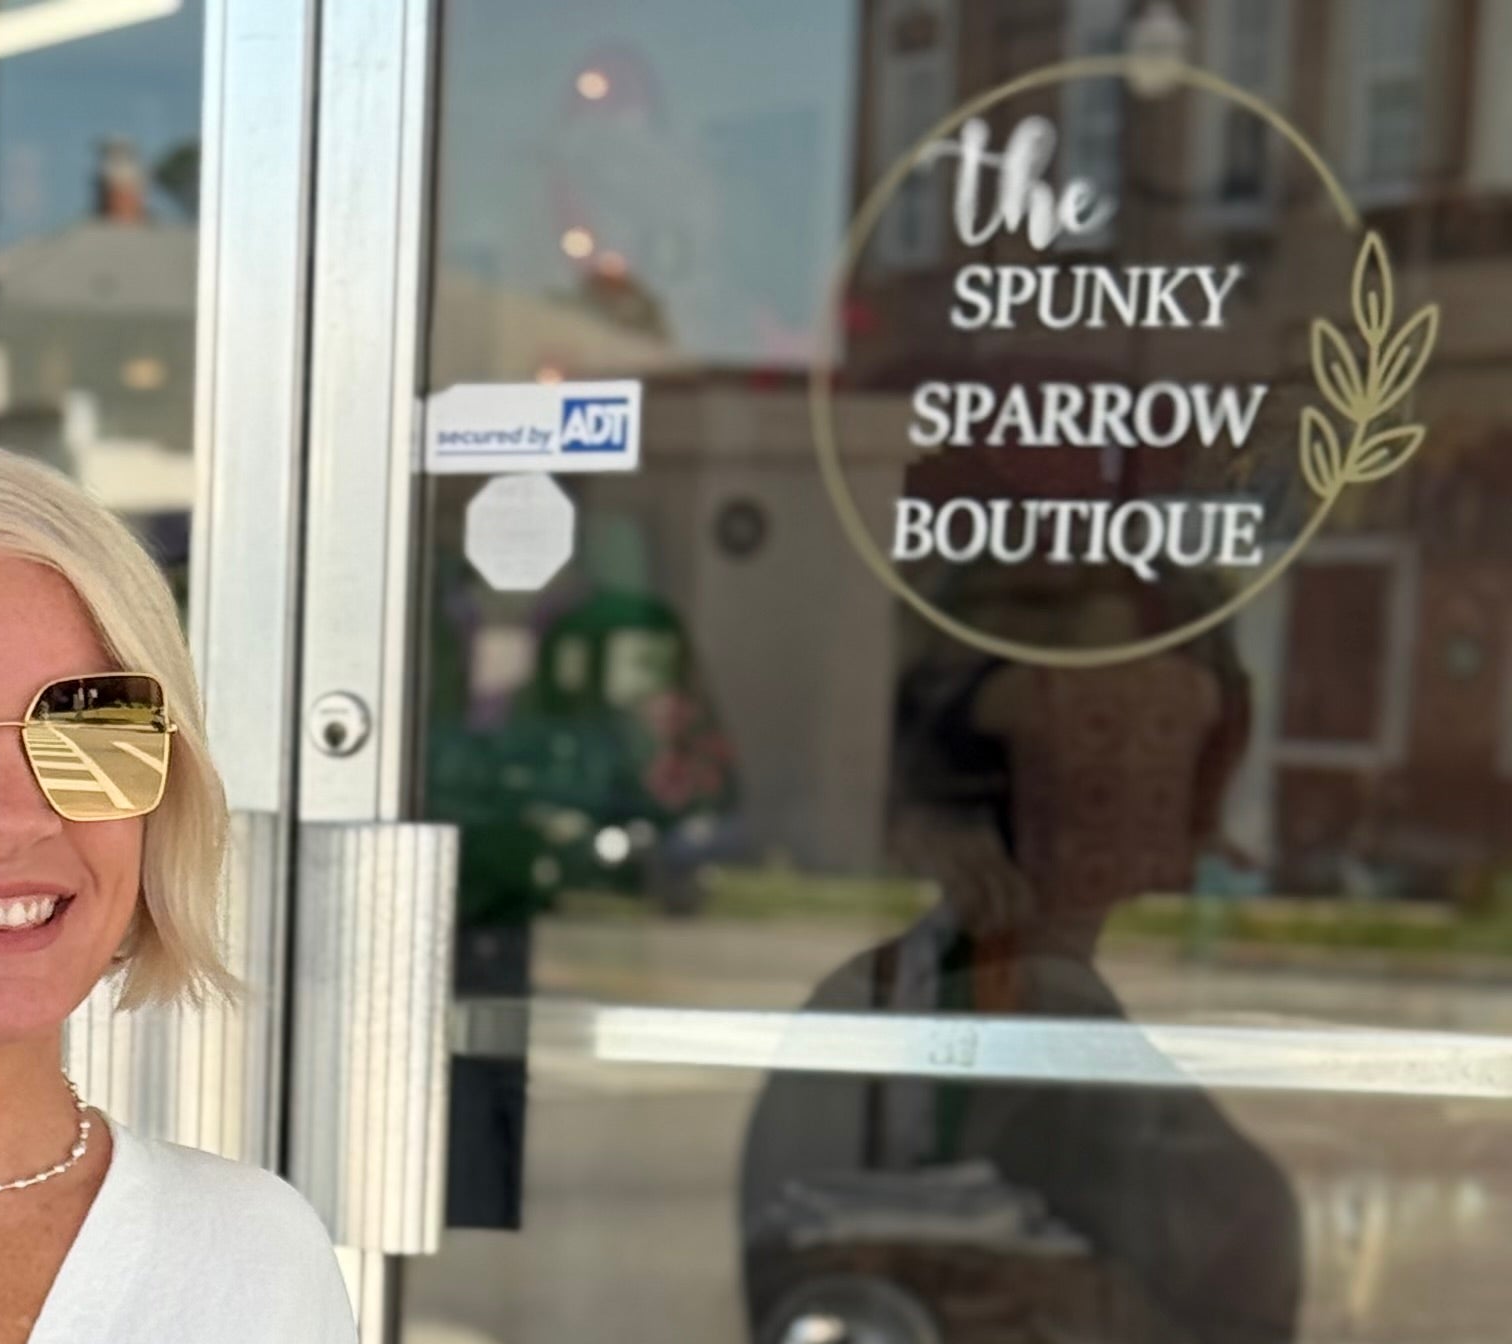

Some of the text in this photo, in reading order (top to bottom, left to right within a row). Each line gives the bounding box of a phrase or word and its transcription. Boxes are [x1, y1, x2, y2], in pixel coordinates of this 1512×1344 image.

[912, 115, 1116, 250] the
[950, 264, 1243, 329] SPUNKY
[437, 403, 628, 448] secured by ADT
[906, 382, 1268, 448] SPARROW
[892, 498, 1264, 580] BOUTIQUE
